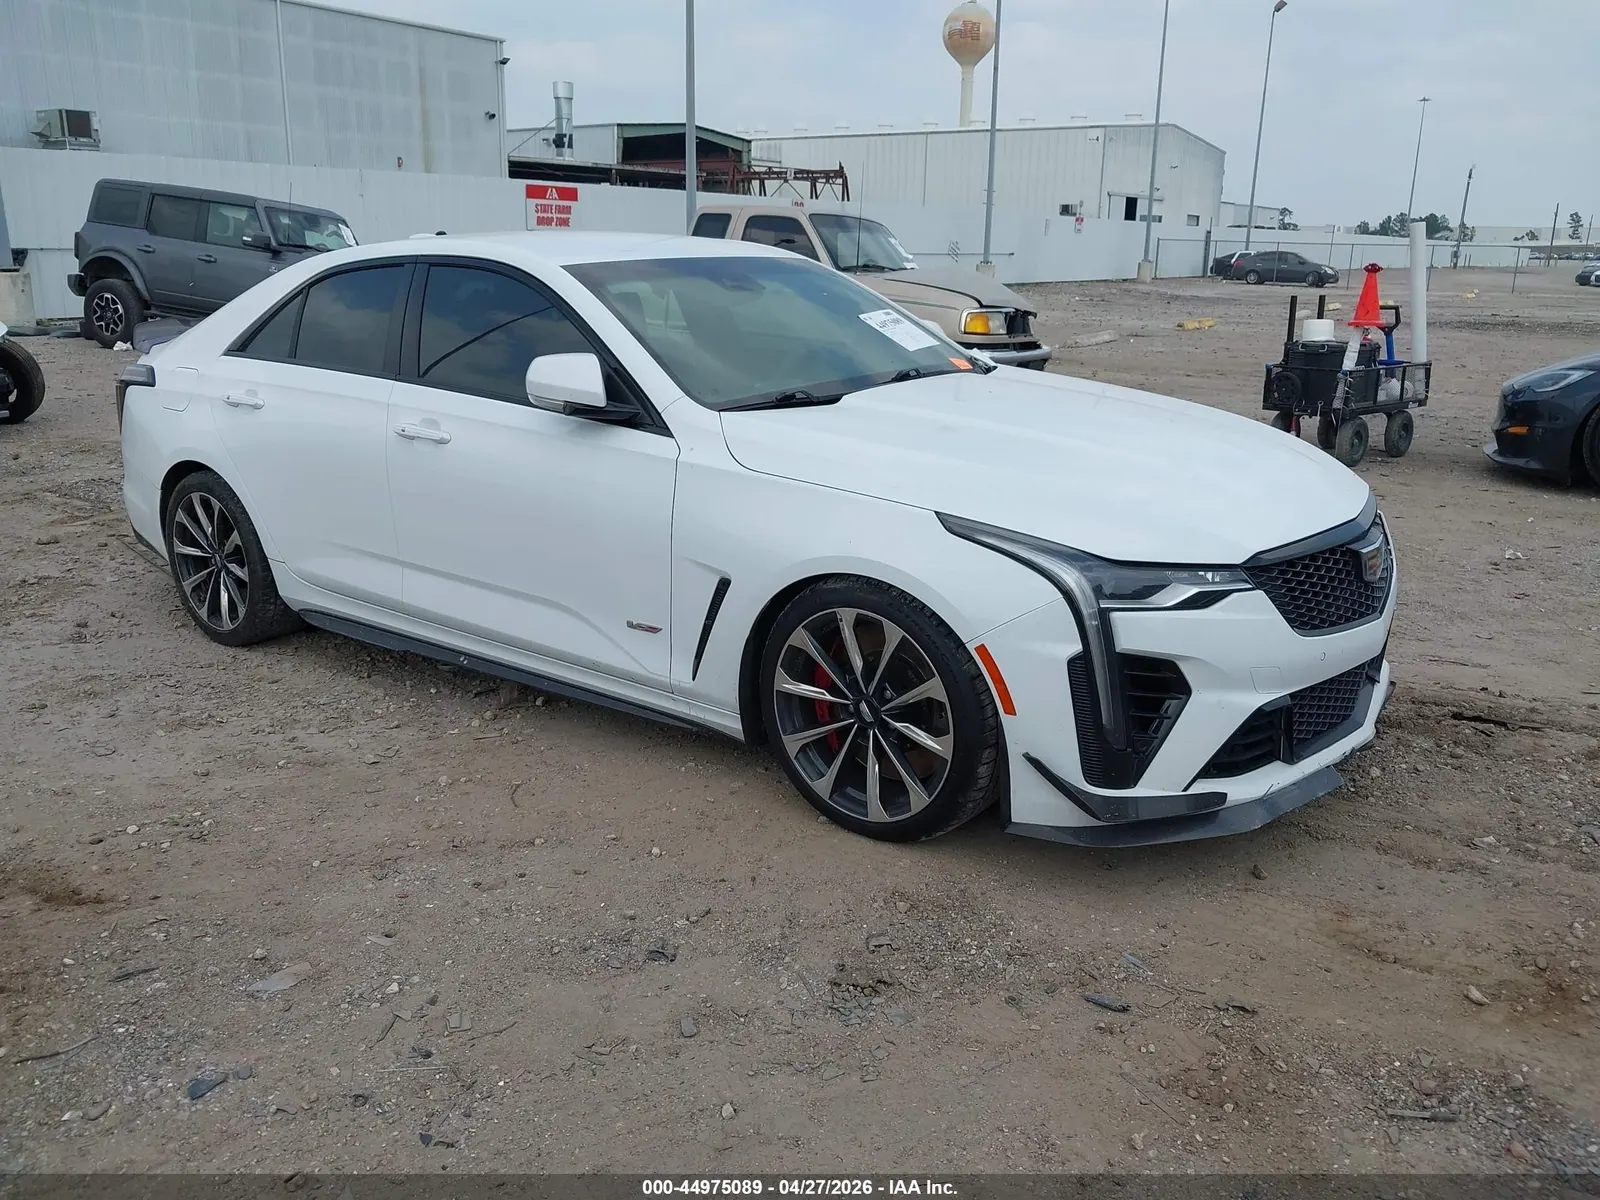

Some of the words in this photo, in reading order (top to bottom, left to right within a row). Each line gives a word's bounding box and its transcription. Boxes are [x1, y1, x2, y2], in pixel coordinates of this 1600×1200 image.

[535, 203, 554, 215] STATE
[554, 204, 572, 216] FARM
[536, 215, 554, 227] DROP
[555, 216, 571, 228] ZONE
